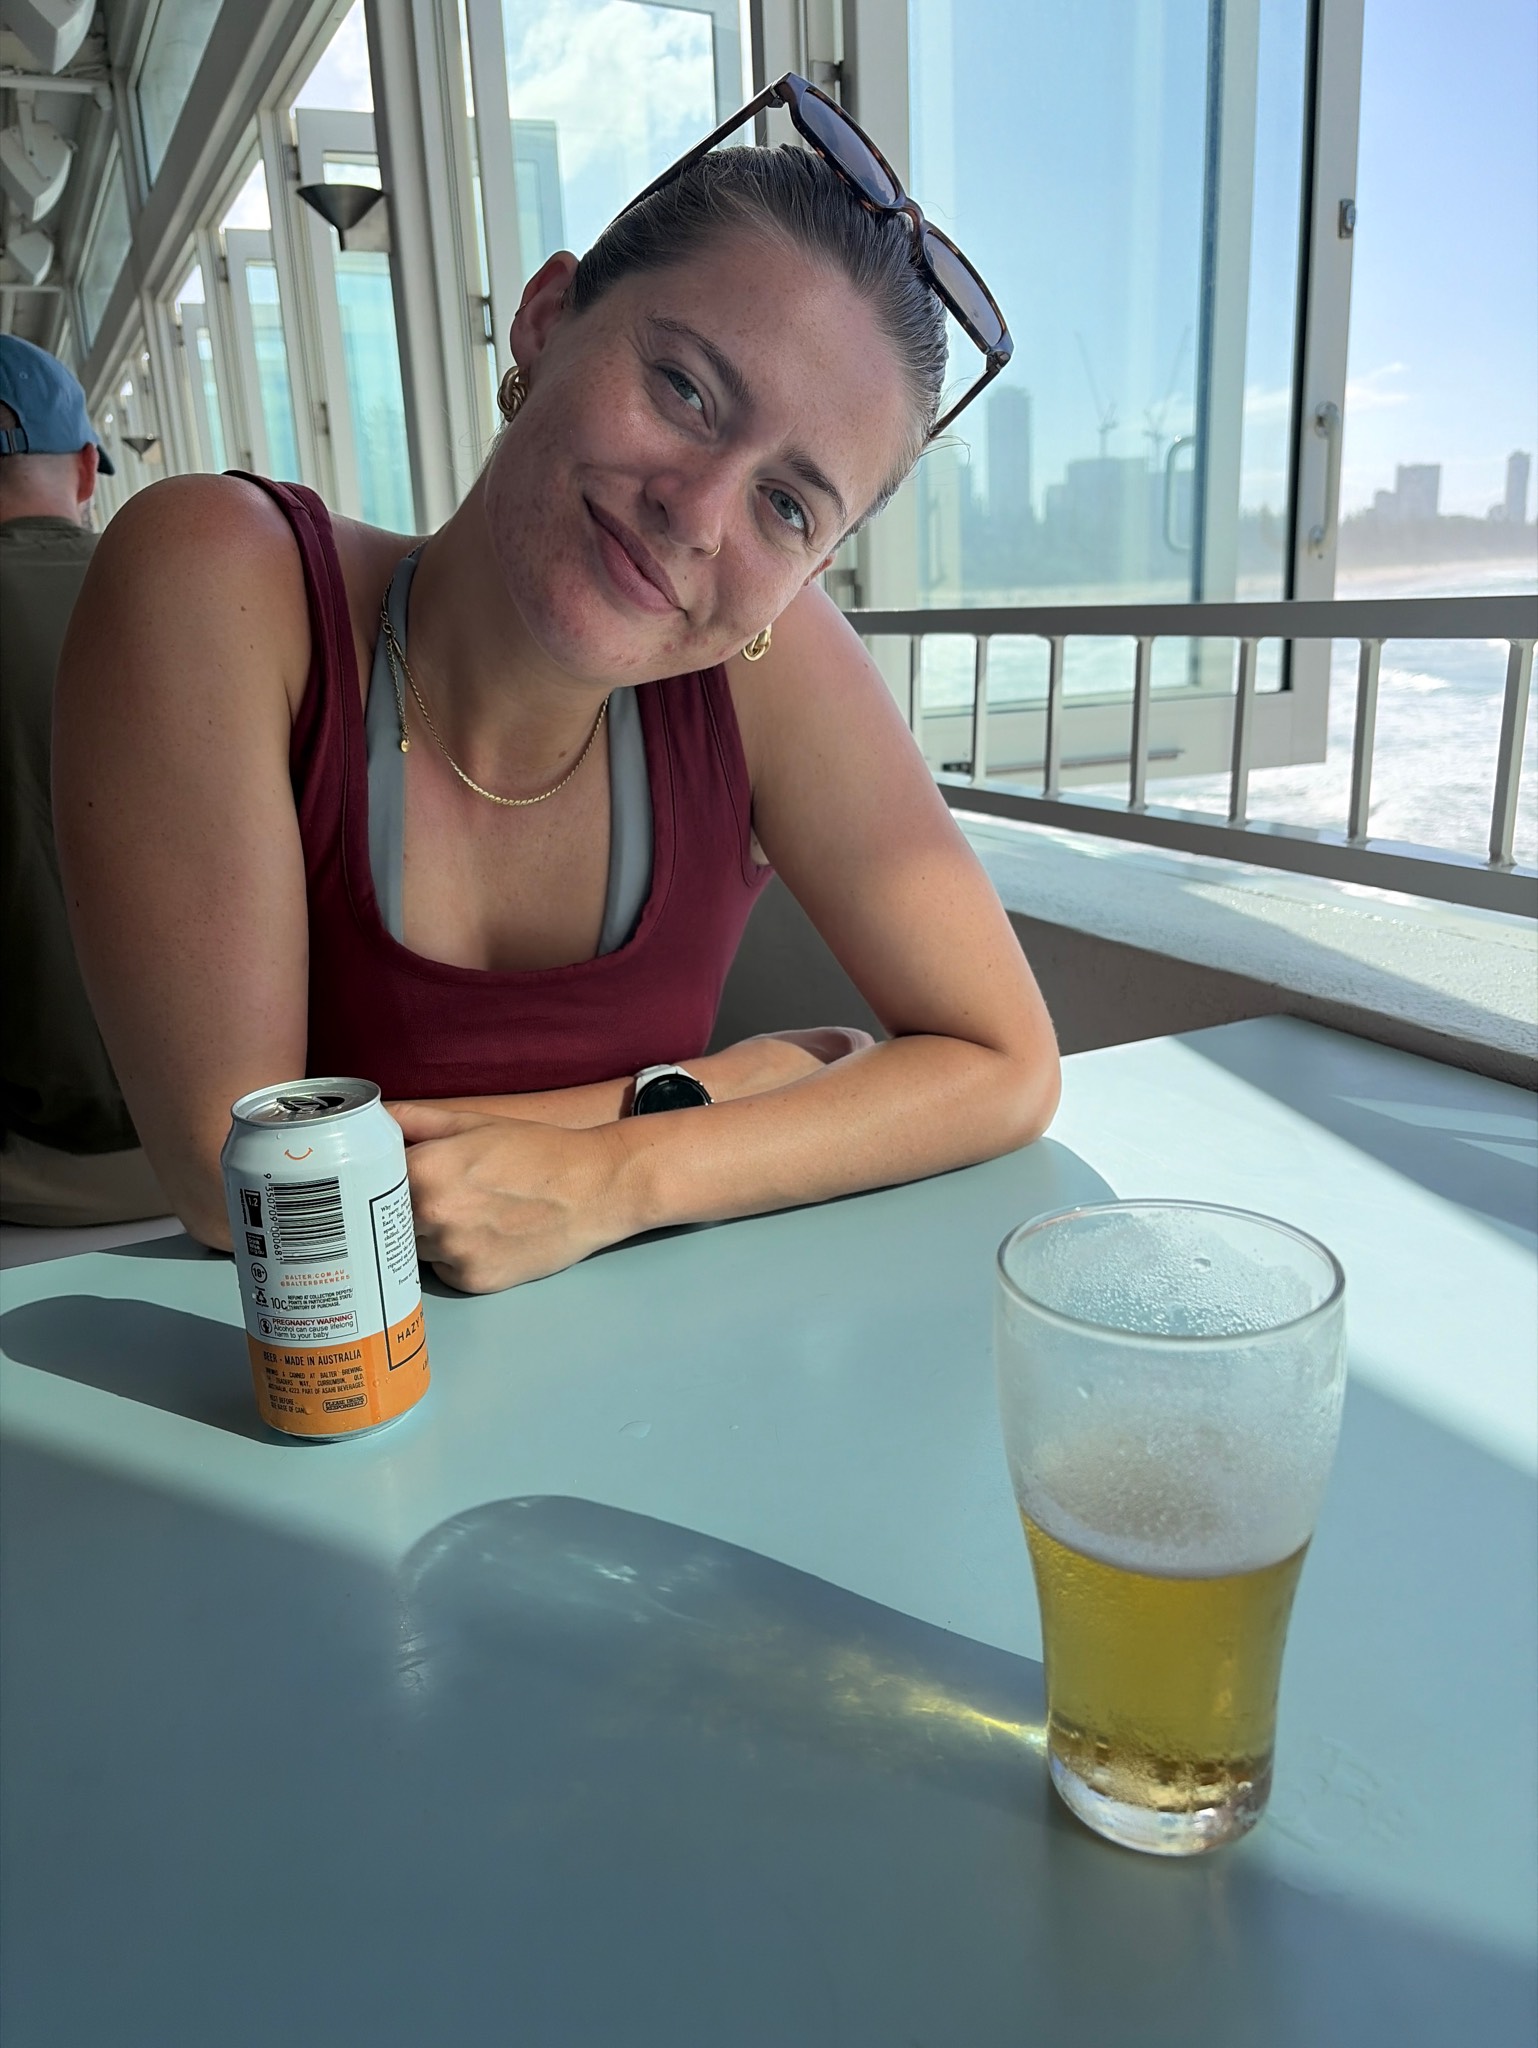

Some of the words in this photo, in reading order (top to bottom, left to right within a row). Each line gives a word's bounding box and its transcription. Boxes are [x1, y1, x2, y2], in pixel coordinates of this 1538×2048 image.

[248, 1197, 258, 1207] 1.2
[265, 1186, 278, 1222] 350709
[271, 1226, 283, 1260] 000681
[253, 1268, 265, 1278] 18+
[280, 1275, 350, 1287] @BALTERBREWERS
[272, 1318, 315, 1326] PREGNANCY
[317, 1314, 353, 1325] WARNING
[330, 1320, 354, 1330] lifelong
[397, 1317, 420, 1343] HAZY
[263, 1351, 278, 1363] BEER
[285, 1355, 304, 1366] MADE
[307, 1355, 315, 1366] IN
[318, 1349, 361, 1365] AUSTRALIA
[320, 1370, 337, 1378] BALTER
